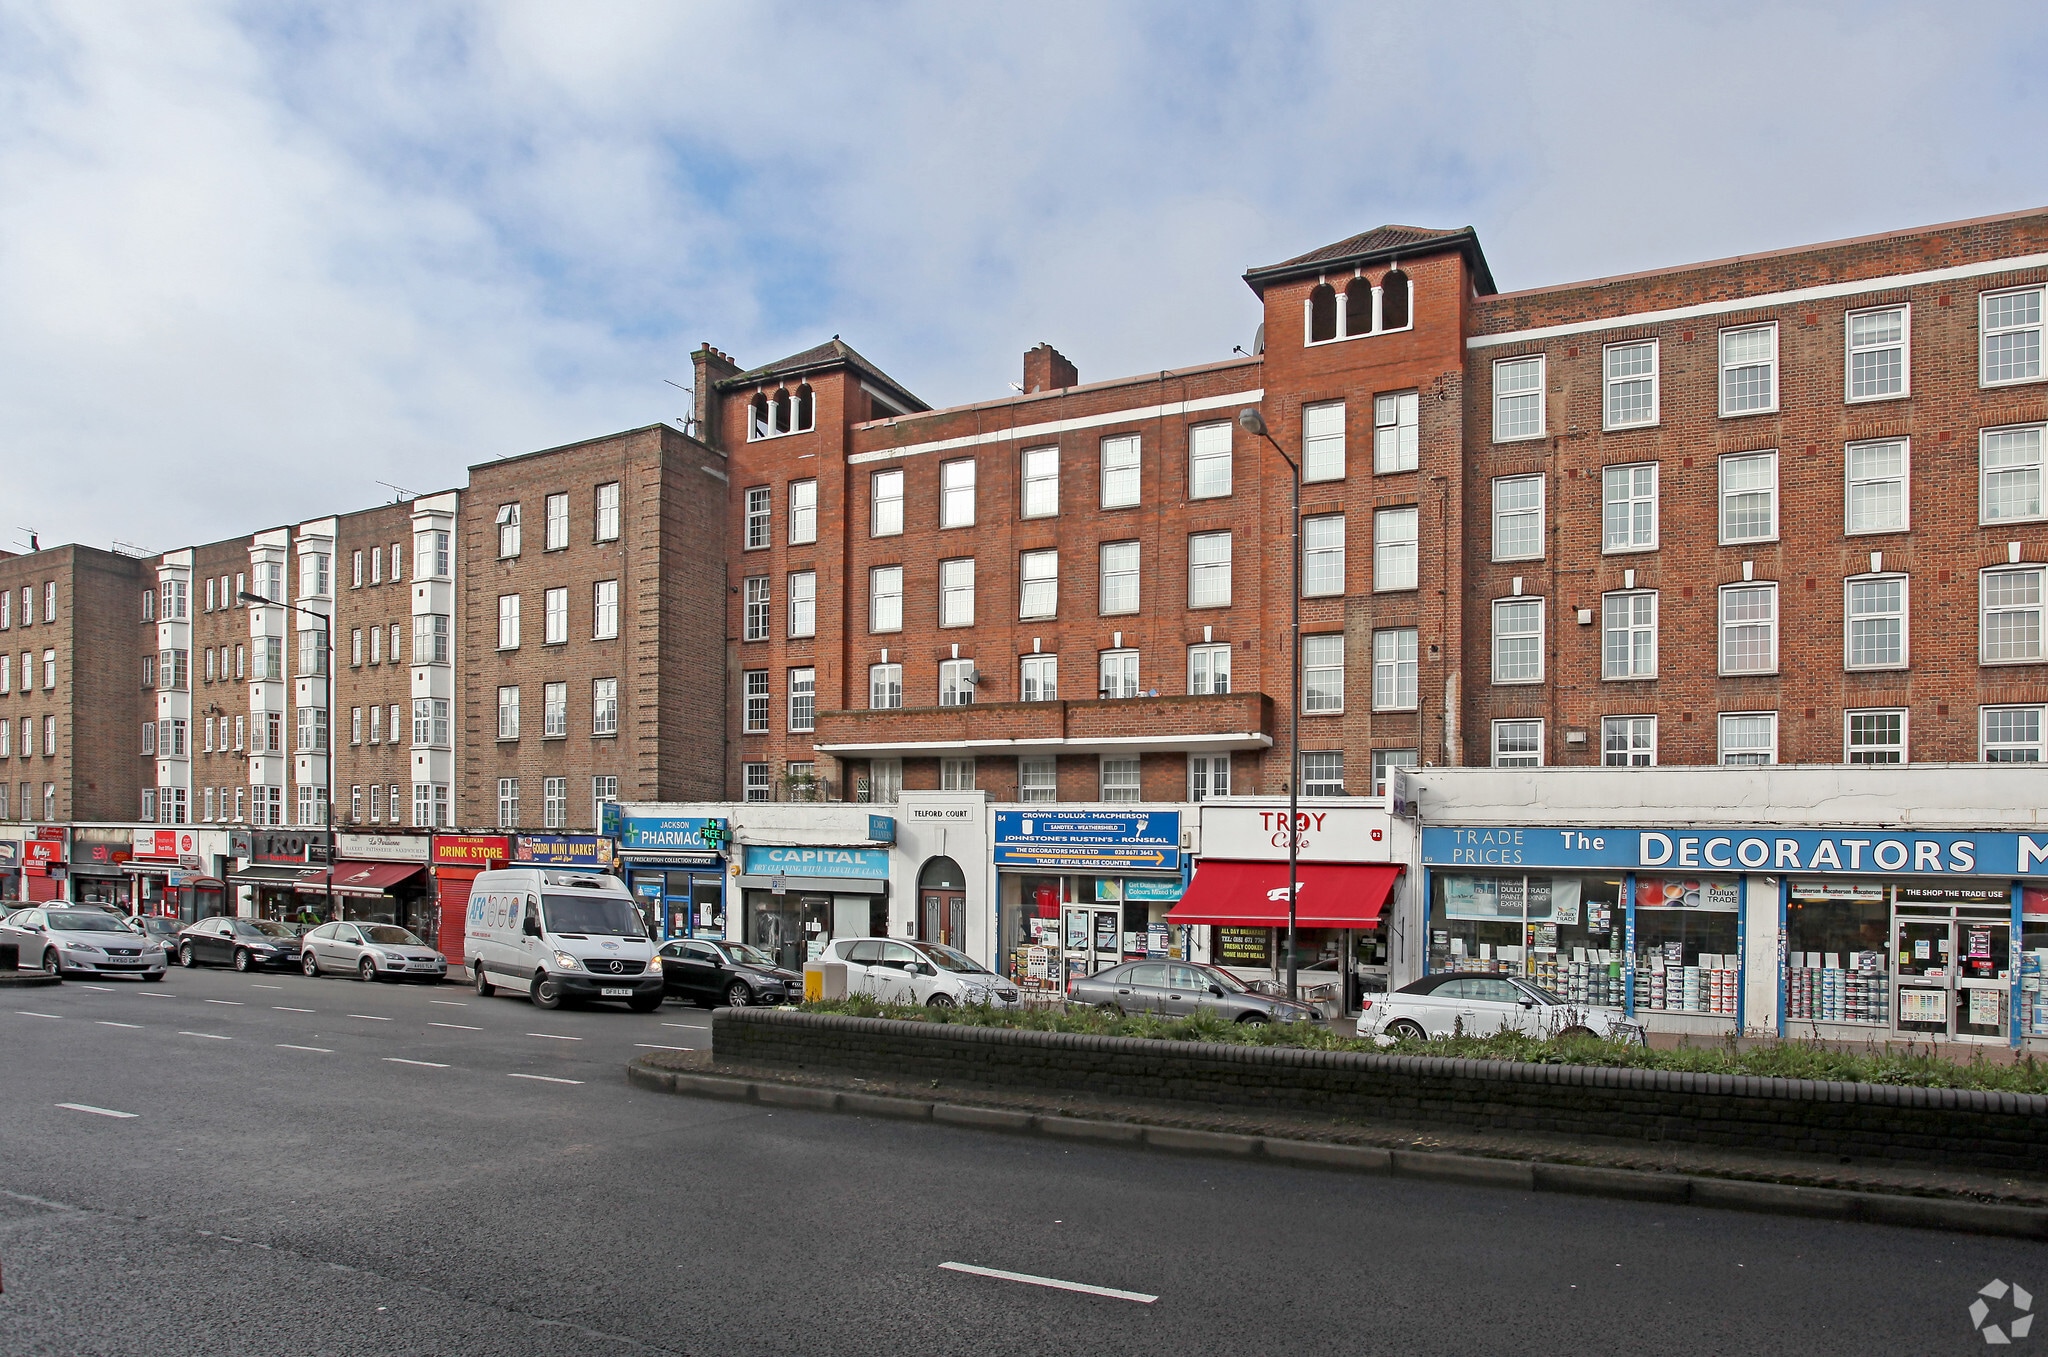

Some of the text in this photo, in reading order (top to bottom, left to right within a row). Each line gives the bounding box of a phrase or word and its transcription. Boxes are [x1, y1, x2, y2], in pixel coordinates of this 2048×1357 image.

[914, 810, 968, 818] TELFORD COURT
[997, 814, 1006, 822] 84
[660, 821, 690, 829] JACKSON
[873, 820, 889, 830] DRY
[1259, 811, 1327, 832] TROY
[871, 830, 892, 840] CLEANERS
[1453, 829, 1524, 845] TRADE
[1560, 830, 1605, 850] The
[440, 846, 503, 859] DRINK STORE
[532, 843, 596, 856] GOLDEN MINI MARKET
[1638, 831, 1976, 873] DECORATORS
[769, 850, 867, 865] CAPITAL
[1453, 848, 1523, 864] PRICES
[767, 864, 800, 872] CLEANING
[829, 866, 850, 874] TOUCH
[862, 867, 883, 875] CLASS
[1709, 888, 1735, 896] Dulux
[1922, 889, 1943, 897] SHOP
[1961, 890, 1986, 898] TRADE
